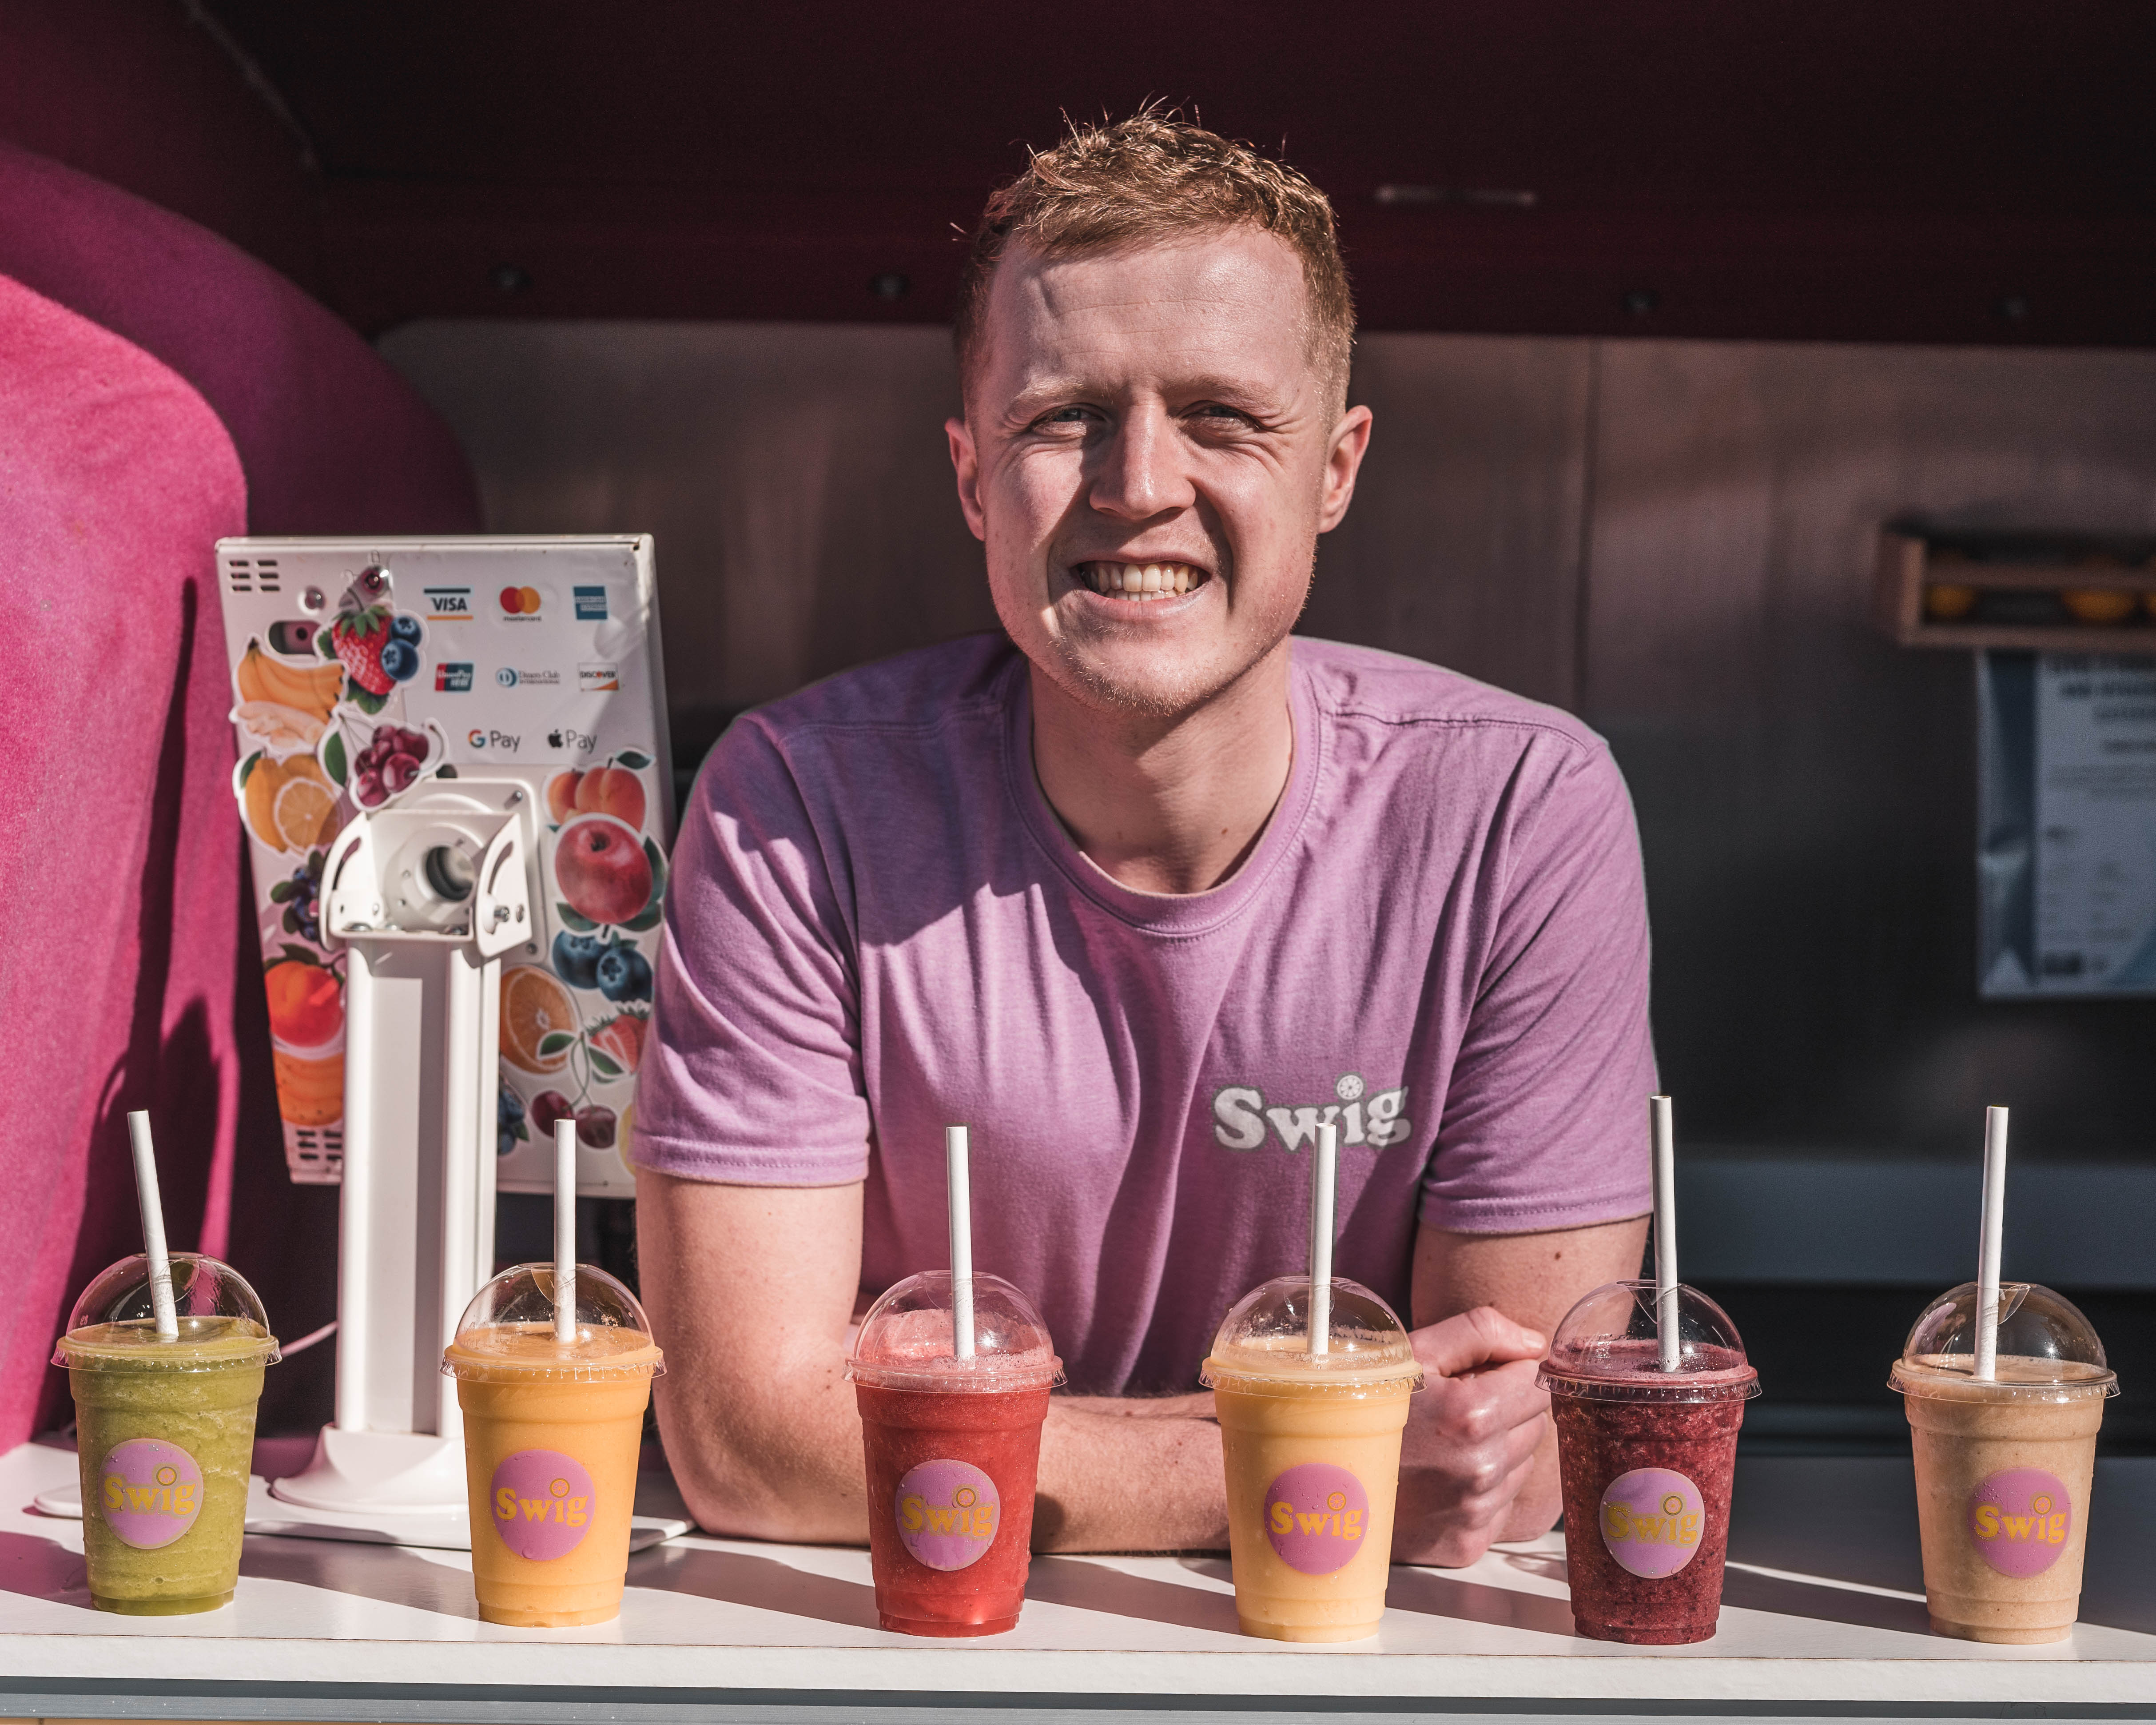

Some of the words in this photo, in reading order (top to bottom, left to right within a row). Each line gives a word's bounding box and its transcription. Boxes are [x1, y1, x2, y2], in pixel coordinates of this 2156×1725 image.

[432, 598, 467, 611] VISA
[490, 730, 521, 753] Pay
[565, 729, 597, 754] Pay
[1214, 1074, 1412, 1151] Swig
[104, 1466, 196, 1515] Swig
[496, 1478, 589, 1527] Swig
[902, 1488, 994, 1536] Swig
[1270, 1491, 1363, 1541] Swig
[1607, 1496, 1699, 1544] Swig
[1975, 1495, 2067, 1544] Swig
